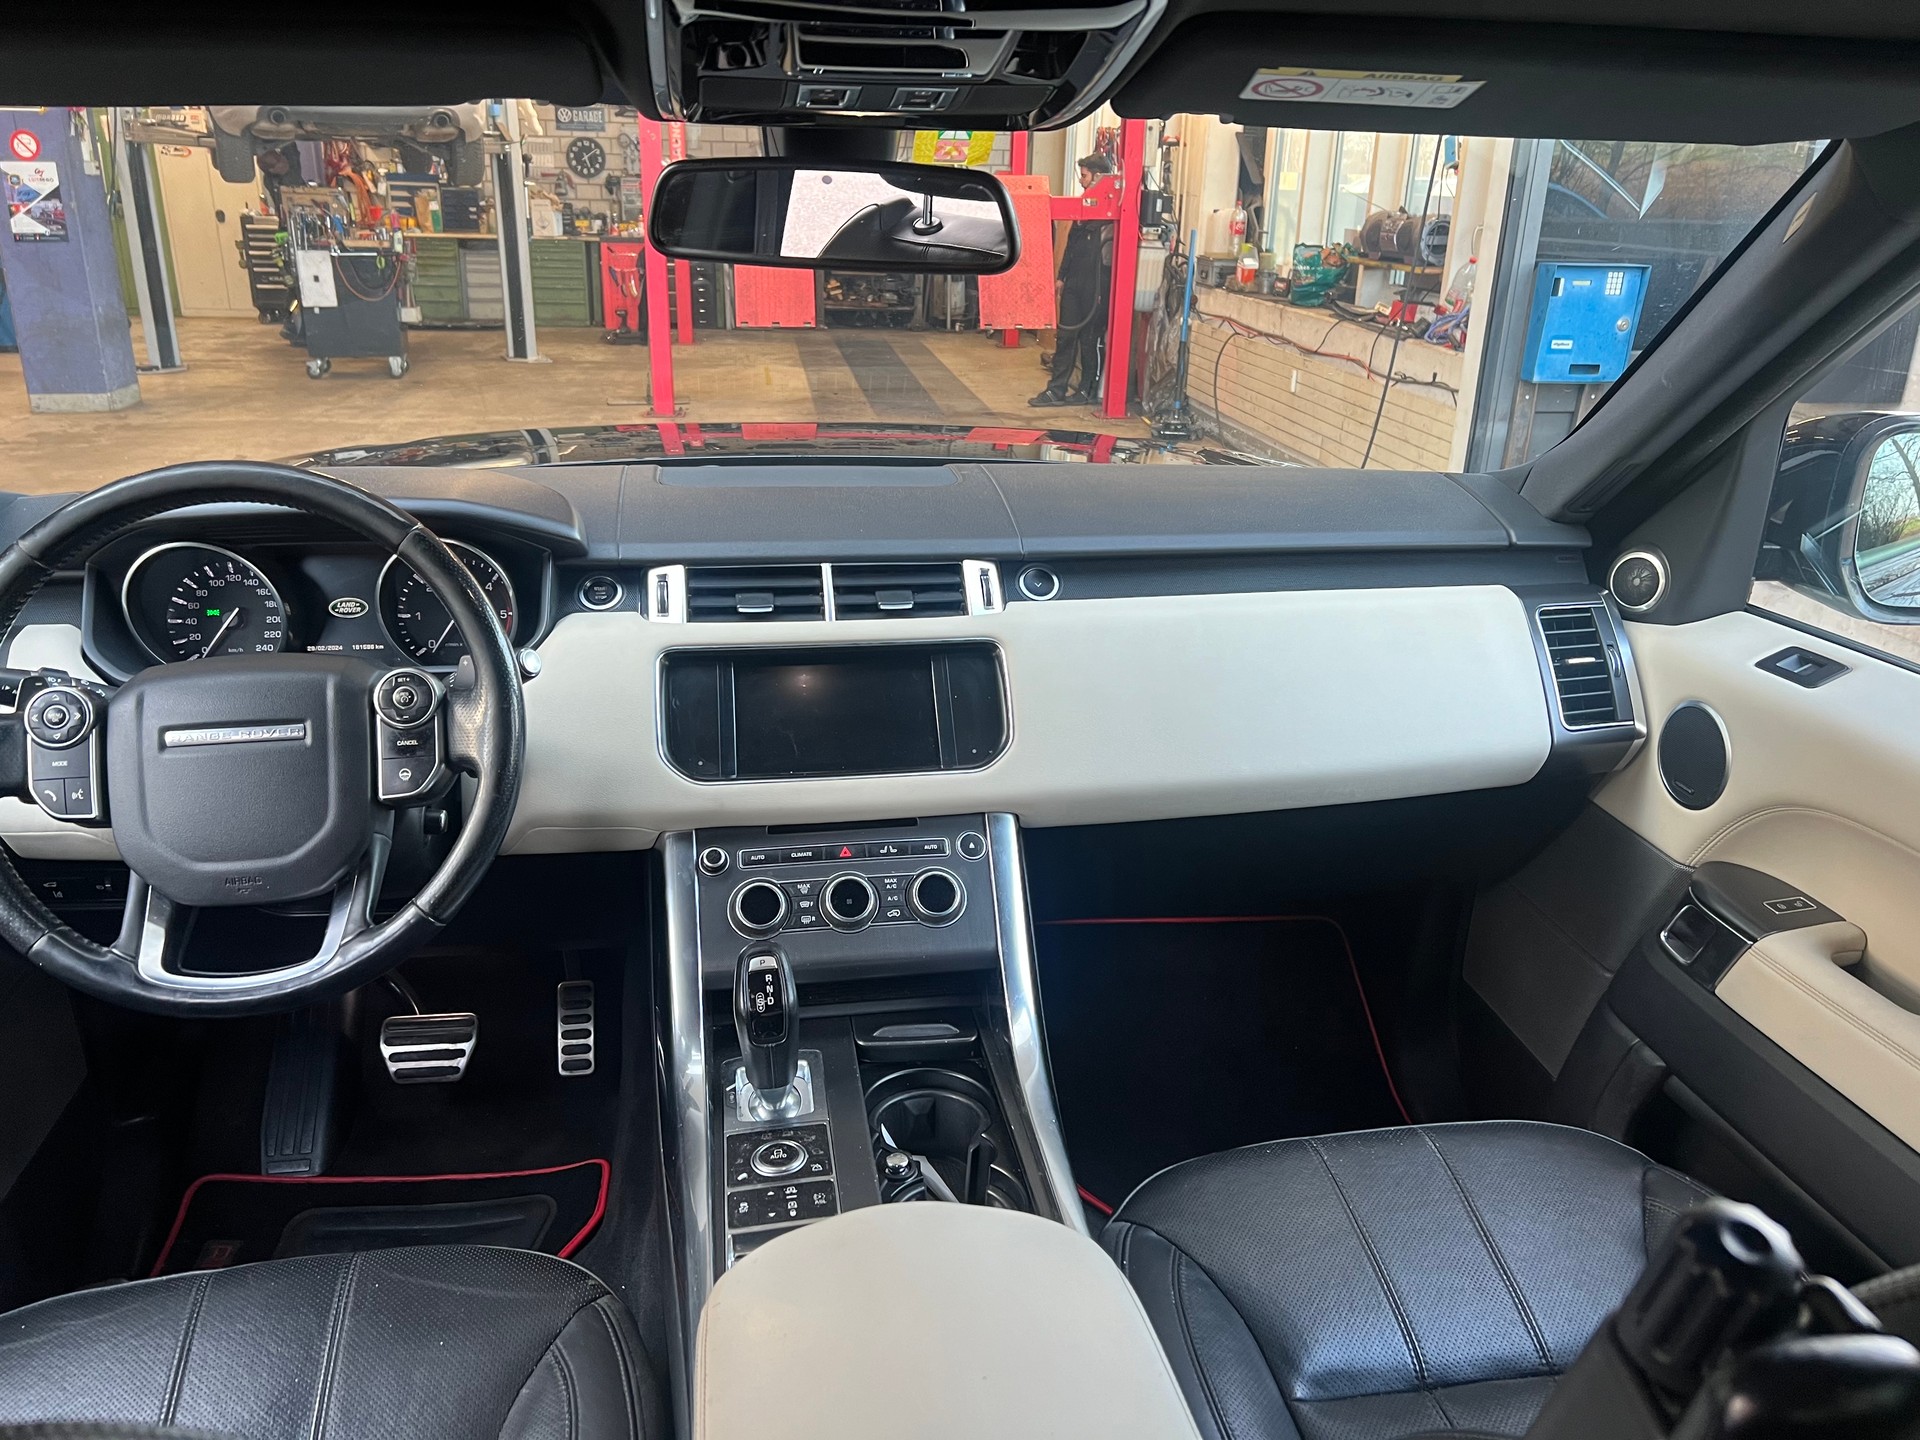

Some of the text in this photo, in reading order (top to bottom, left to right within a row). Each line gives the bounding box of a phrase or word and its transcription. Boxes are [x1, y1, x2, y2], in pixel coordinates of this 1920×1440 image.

[1363, 72, 1443, 82] AIRBAG
[572, 110, 603, 123] GARAGE
[208, 579, 225, 587] 100
[485, 582, 493, 591] 4
[195, 589, 208, 597] 80
[415, 612, 421, 620] 1
[500, 610, 508, 618] 5
[428, 640, 436, 648] 0
[171, 727, 302, 744] RANGE ROVER
[224, 876, 262, 887] AIRBAG
[766, 974, 772, 982] R
[766, 985, 774, 993] N
[767, 996, 774, 1005] D
